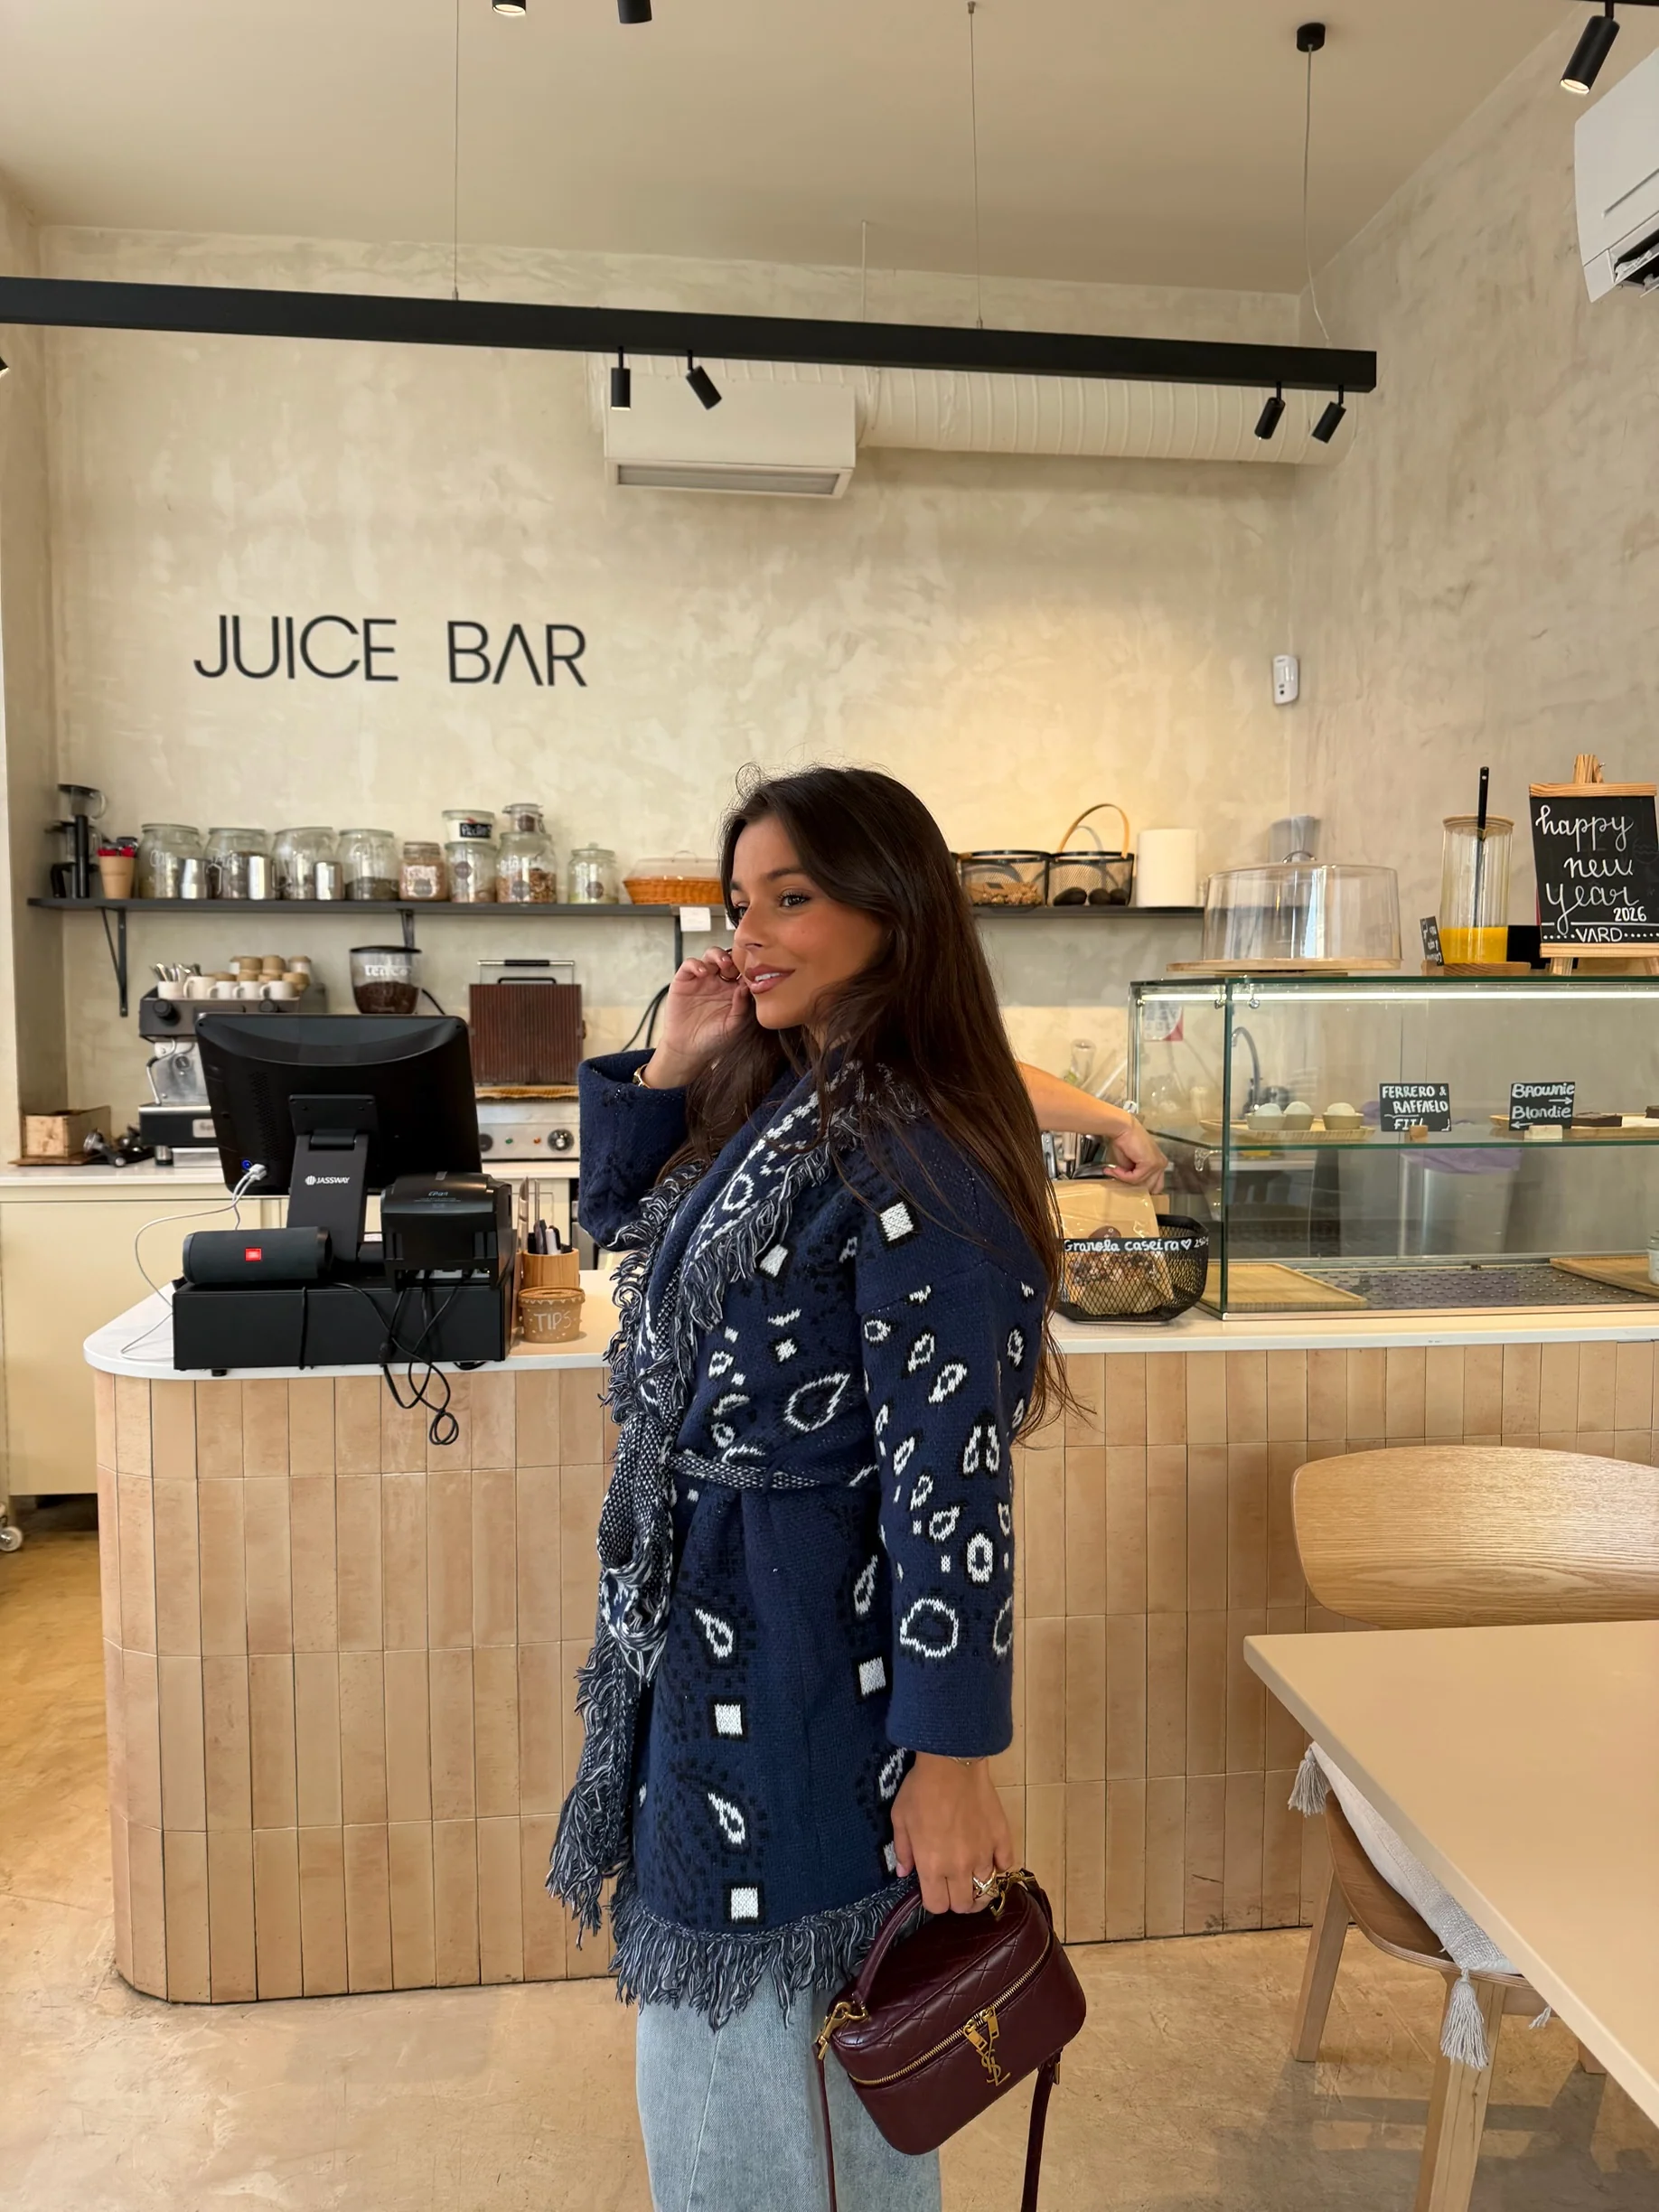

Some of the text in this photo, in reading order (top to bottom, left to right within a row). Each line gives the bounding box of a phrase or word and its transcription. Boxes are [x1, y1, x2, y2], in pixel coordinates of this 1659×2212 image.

[193, 614, 587, 687] JUICE BAR
[1535, 804, 1634, 852] happy
[1563, 858, 1634, 878] new
[1545, 883, 1639, 935] year
[1613, 906, 1647, 922] 2026
[1575, 927, 1622, 942] VARD
[1382, 1085, 1447, 1099] FERRERO &
[1392, 1100, 1448, 1114] RAFFAELO
[1511, 1105, 1572, 1120] Blondie
[316, 1176, 351, 1185] JASSWAY
[1064, 1239, 1120, 1252] Granola
[1124, 1238, 1179, 1251] caseira
[533, 1310, 572, 1332] TIPS
